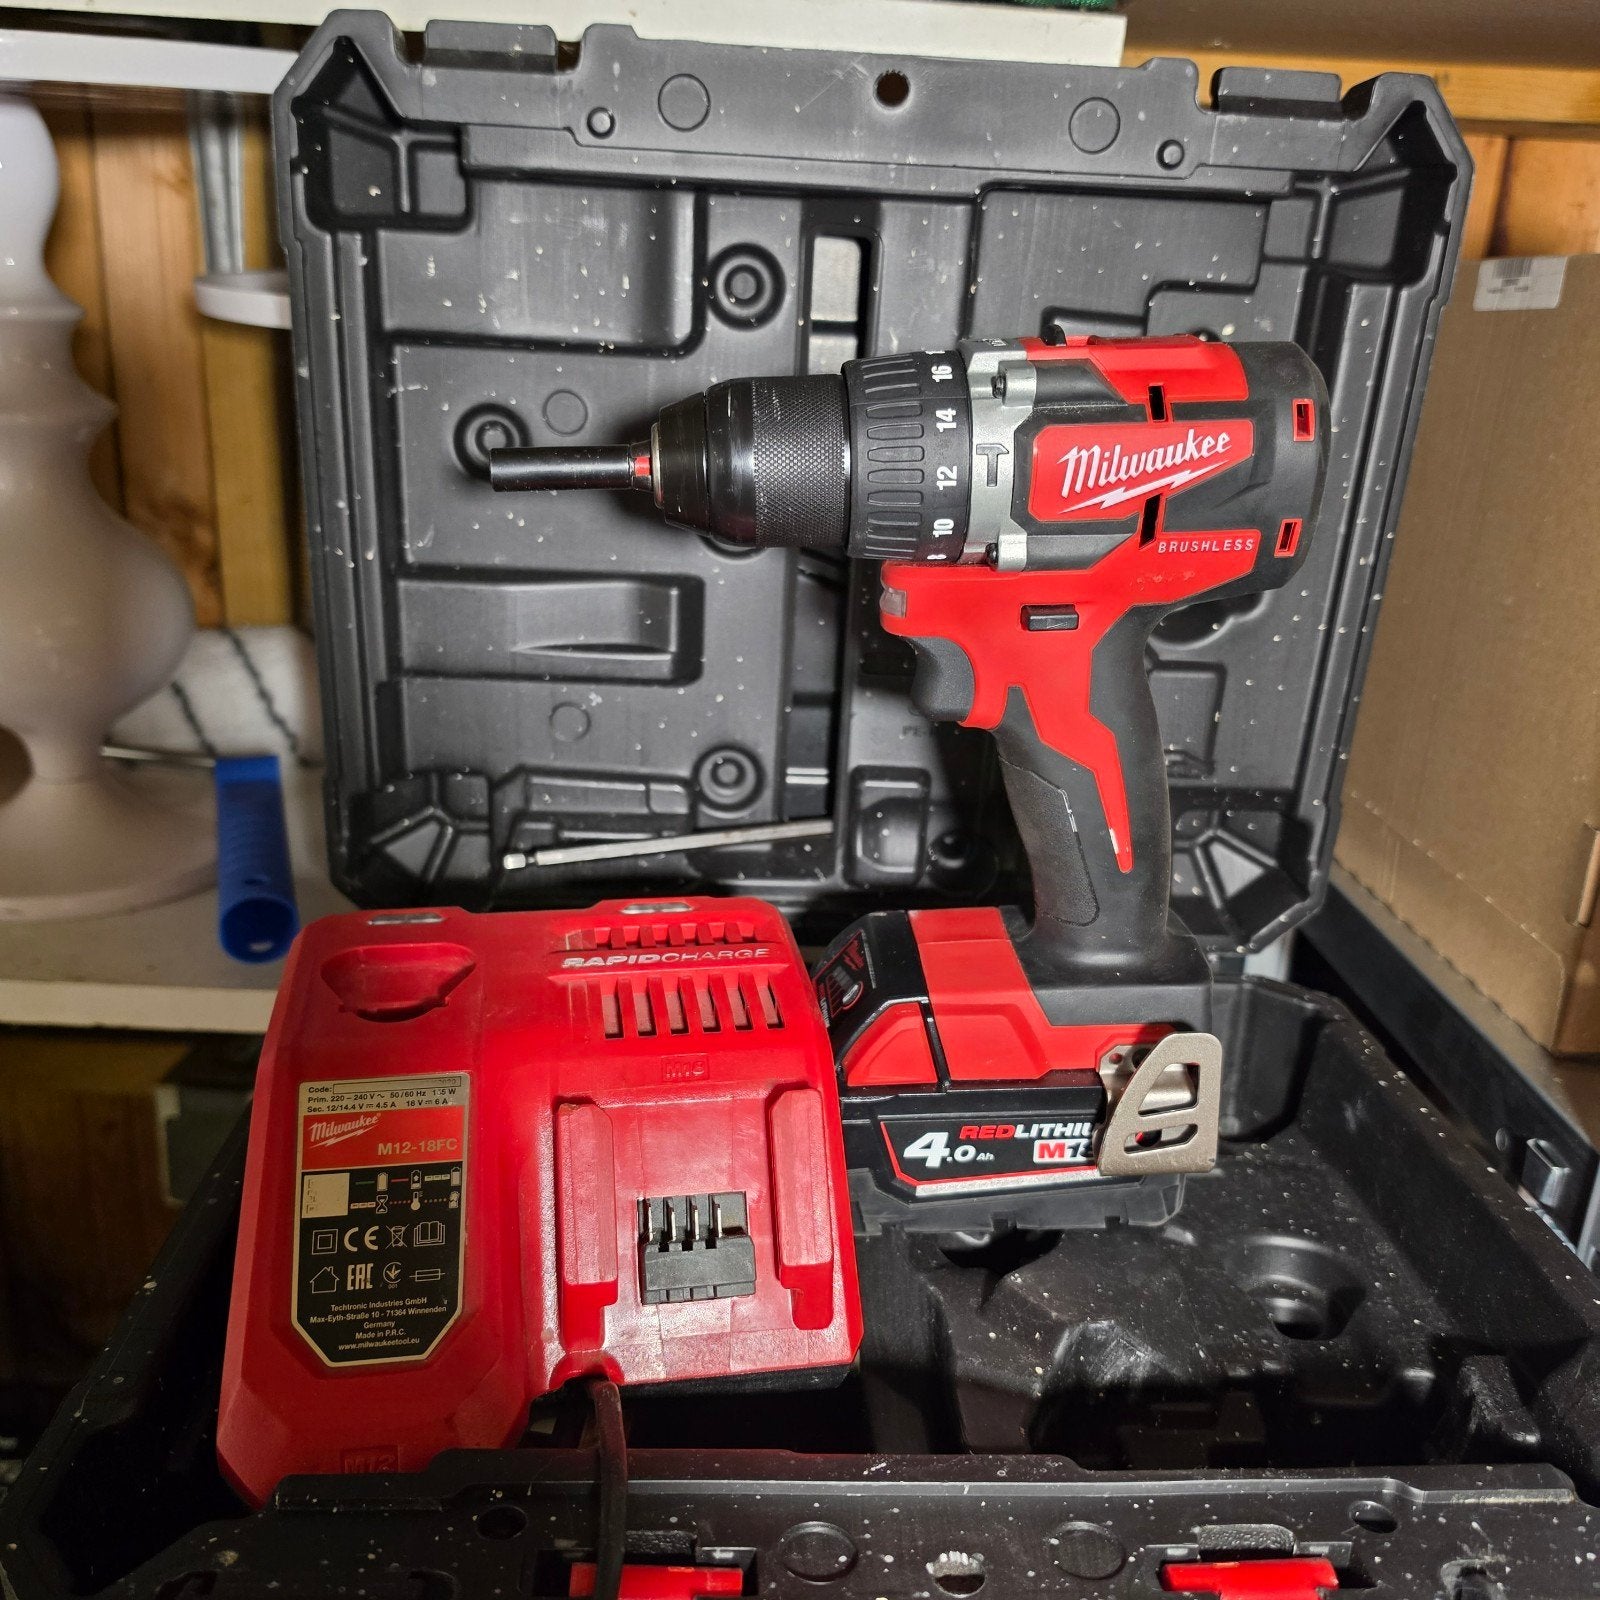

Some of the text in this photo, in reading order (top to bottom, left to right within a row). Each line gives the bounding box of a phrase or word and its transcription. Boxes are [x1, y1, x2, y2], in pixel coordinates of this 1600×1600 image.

[931, 365, 953, 382] 16
[936, 409, 958, 433] 14
[1056, 428, 1232, 498] Milwaukee
[936, 465, 958, 490] 12
[933, 518, 954, 538] 10
[1157, 538, 1255, 554] BRUSHLESS
[561, 948, 770, 969] RAPIDCHARGE
[308, 1086, 332, 1094] Code:
[308, 1096, 328, 1104] Prim.
[326, 1103, 356, 1112] 12/14.4
[308, 1115, 380, 1142] Milwaukee
[959, 1122, 1095, 1140] REDLITHIU
[377, 1138, 458, 1156] M12-18FC
[903, 1131, 995, 1168] 4.0 Ah
[330, 1297, 427, 1312] Techtronic Industries GmbH
[310, 1312, 370, 1324] Max-Eyth-Straße
[408, 1305, 447, 1316] Winnenden
[364, 1320, 396, 1329] Germany
[356, 1332, 375, 1340] Made
[385, 1328, 406, 1336] P.R.C.
[338, 1337, 420, 1351] www.milwaukeetool.eu
